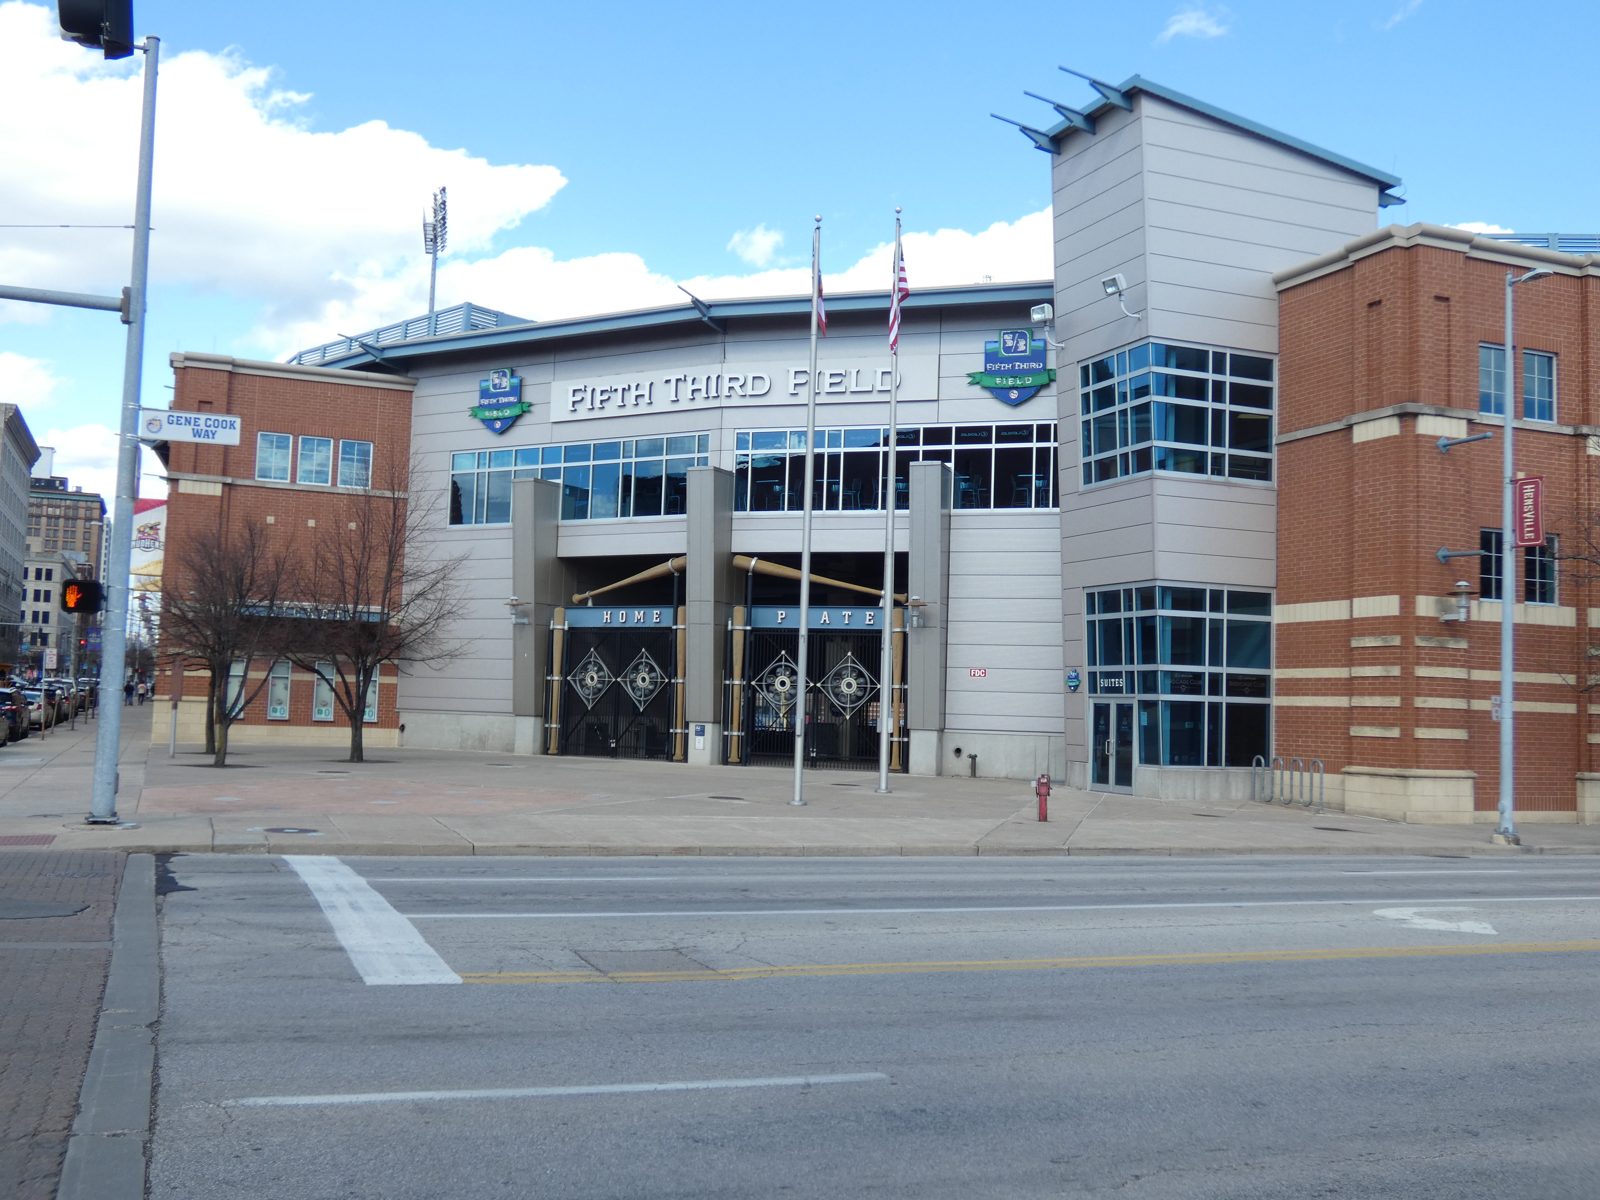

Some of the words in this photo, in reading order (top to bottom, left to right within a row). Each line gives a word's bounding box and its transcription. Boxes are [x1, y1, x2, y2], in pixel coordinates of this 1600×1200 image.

[986, 363, 1012, 371] FIFTH
[1014, 362, 1042, 370] THIRD
[567, 382, 654, 412] FIFTH
[664, 371, 772, 402] THIRD
[167, 414, 201, 427] GENE
[204, 417, 237, 430] COOK
[192, 428, 218, 440] WAY
[1523, 485, 1535, 539] HENSVILLE
[603, 610, 661, 623] HOME
[777, 610, 875, 625] PATE
[1100, 678, 1124, 687] SUITES
